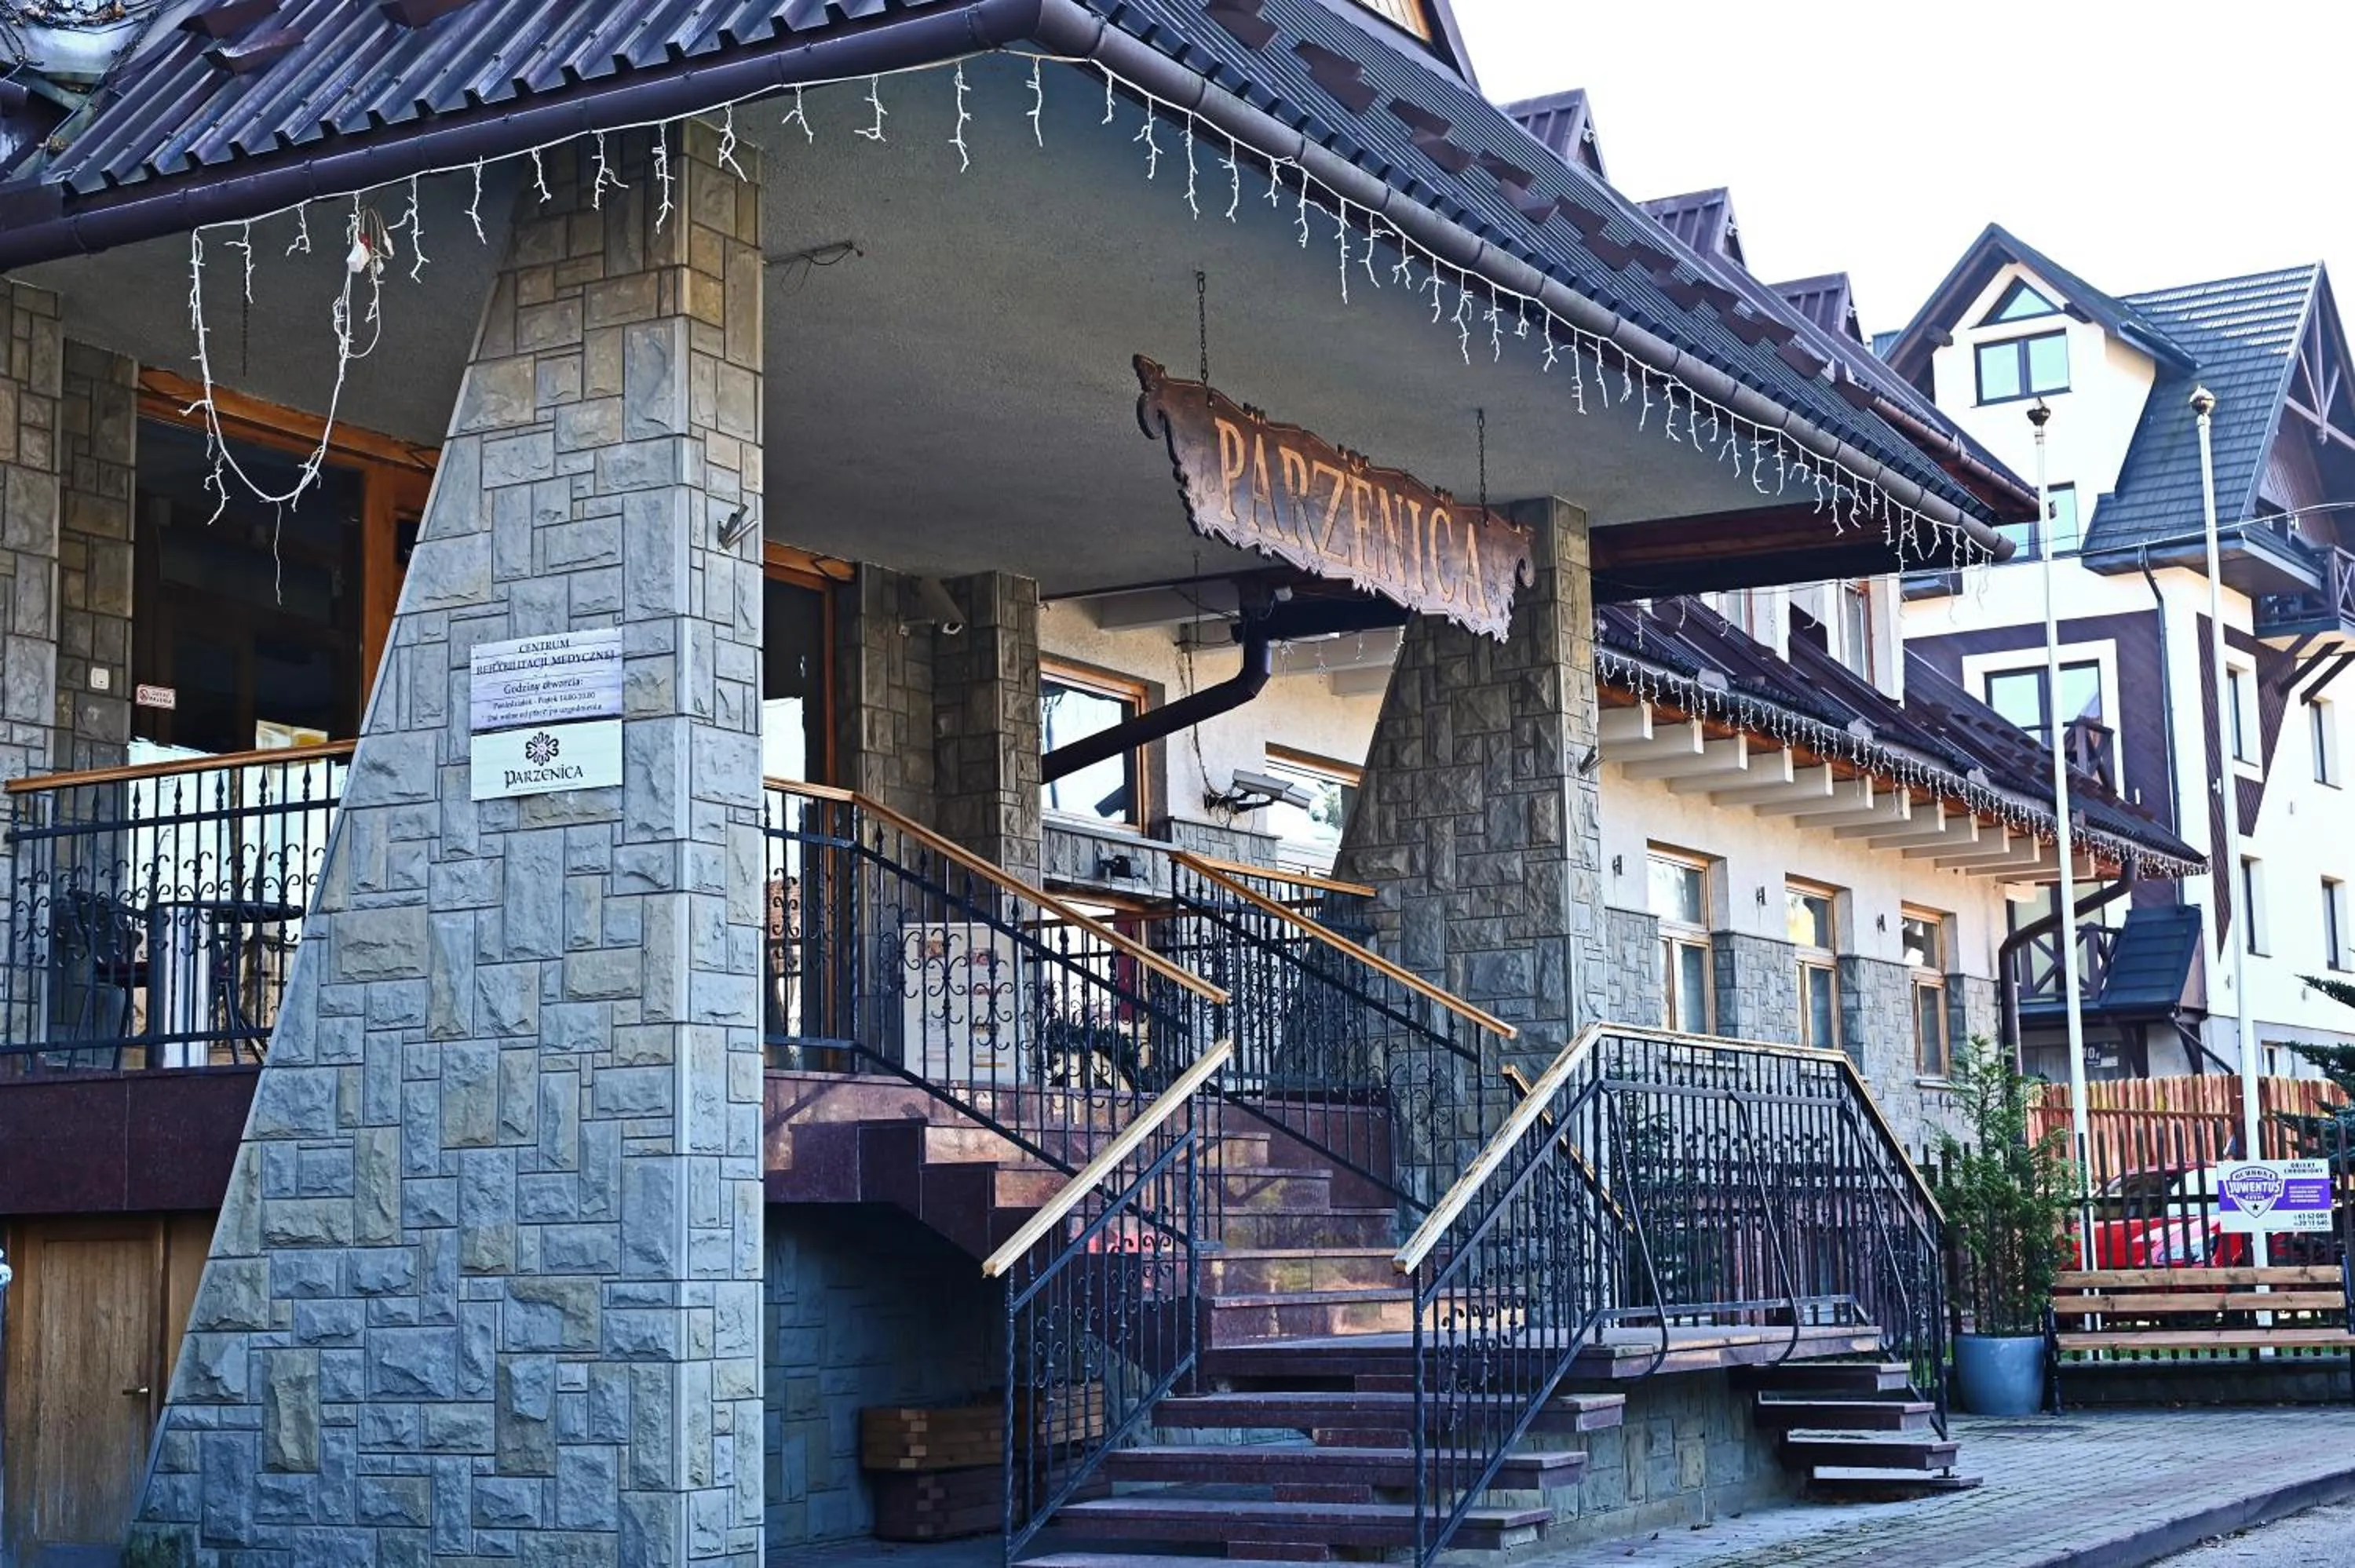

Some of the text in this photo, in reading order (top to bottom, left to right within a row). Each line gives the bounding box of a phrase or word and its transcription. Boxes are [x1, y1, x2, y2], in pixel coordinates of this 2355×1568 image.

[1214, 417, 1492, 618] PARZENICA
[518, 638, 571, 654] CENTRUM
[550, 650, 615, 666] MEDYCZNEJ
